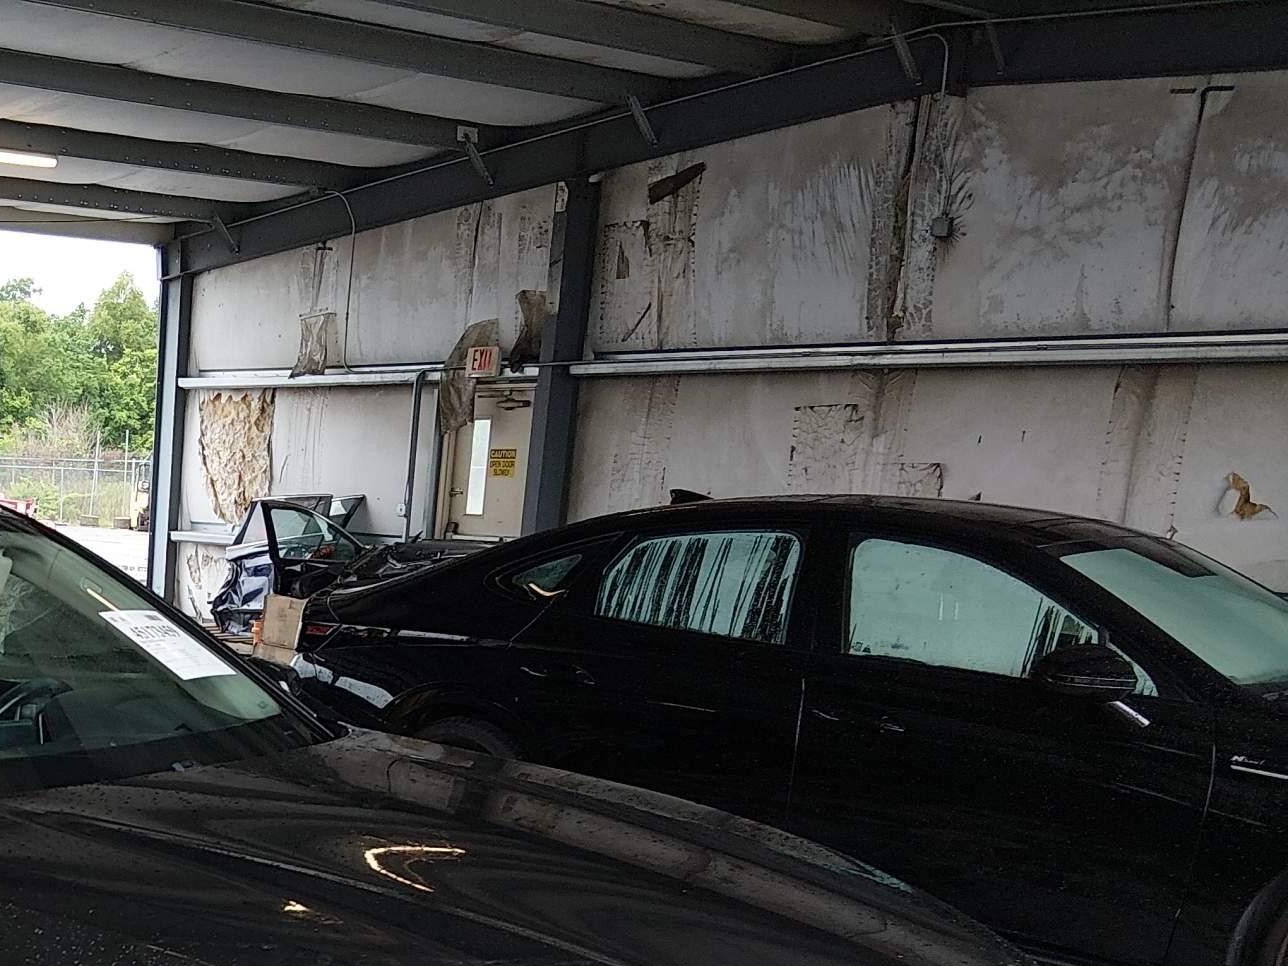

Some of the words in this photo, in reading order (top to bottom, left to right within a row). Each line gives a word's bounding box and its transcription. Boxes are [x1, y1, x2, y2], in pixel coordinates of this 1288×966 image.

[490, 450, 517, 459] CAUTION
[489, 460, 501, 469] OPEN
[502, 460, 515, 468] DOOR
[493, 469, 510, 477] SLOWLY
